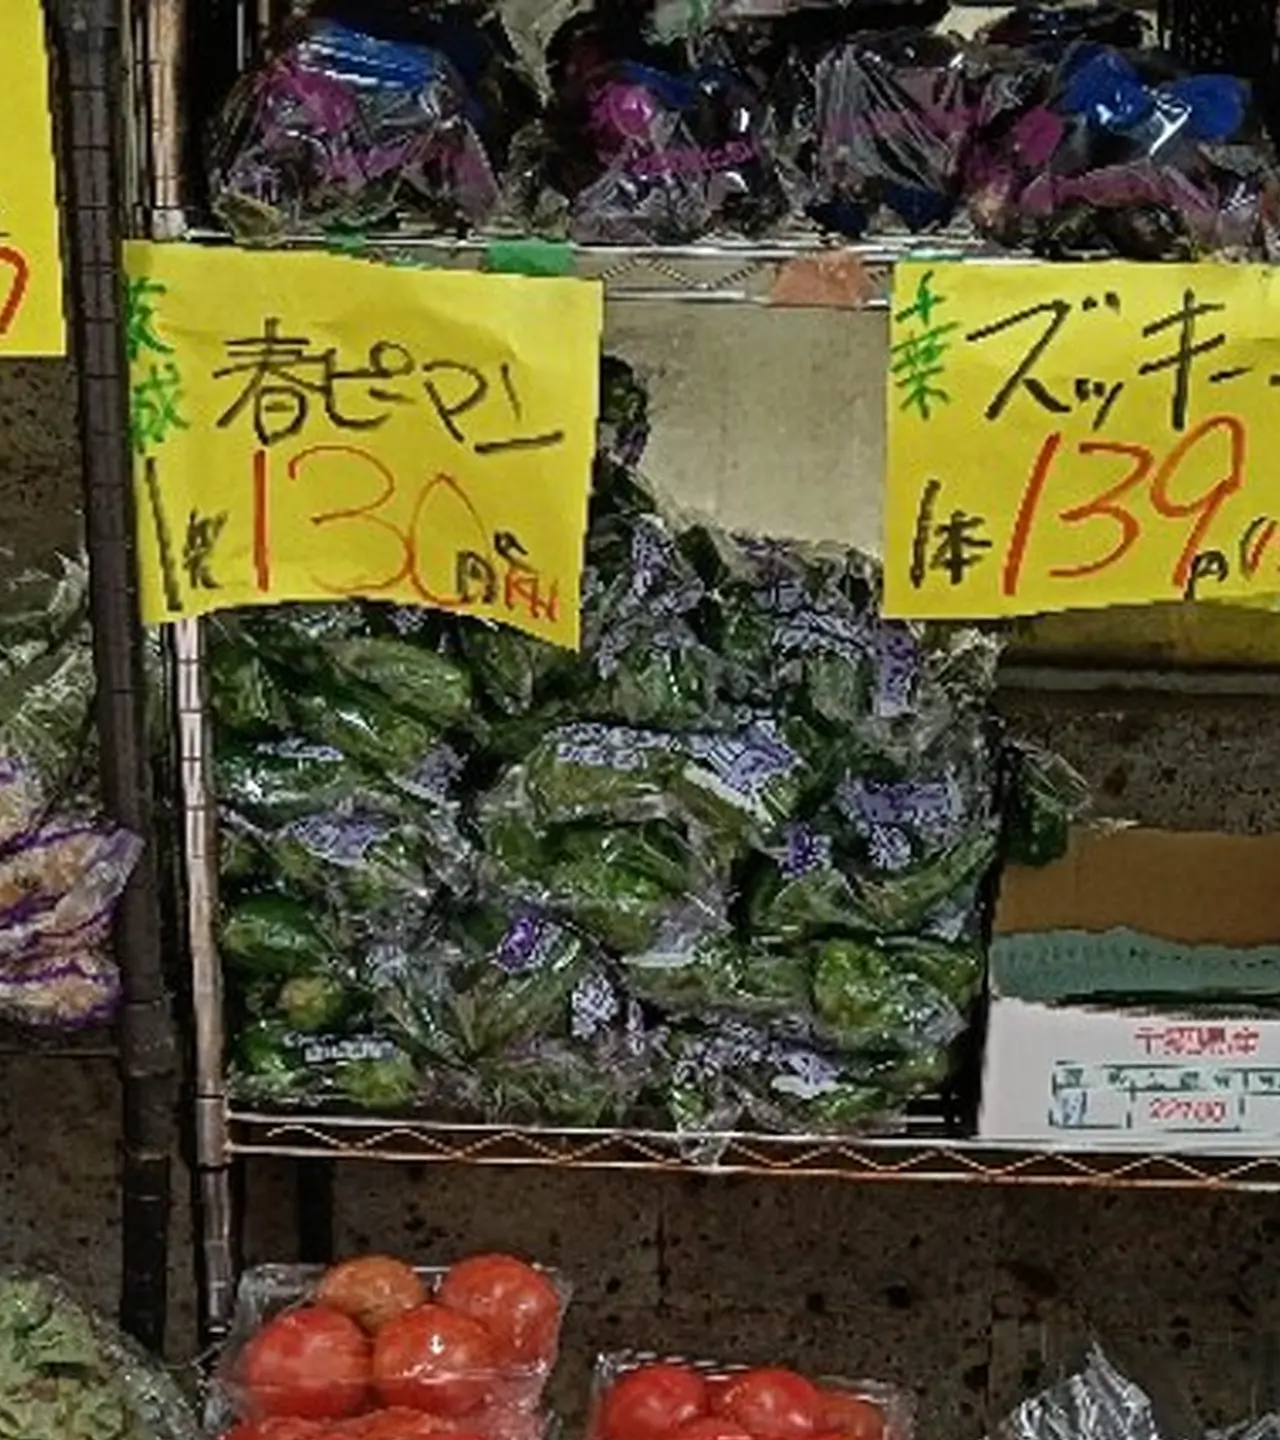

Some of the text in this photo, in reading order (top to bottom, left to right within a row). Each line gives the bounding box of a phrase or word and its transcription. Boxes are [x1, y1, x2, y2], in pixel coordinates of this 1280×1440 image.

[211, 316, 565, 456] 春ピーマン
